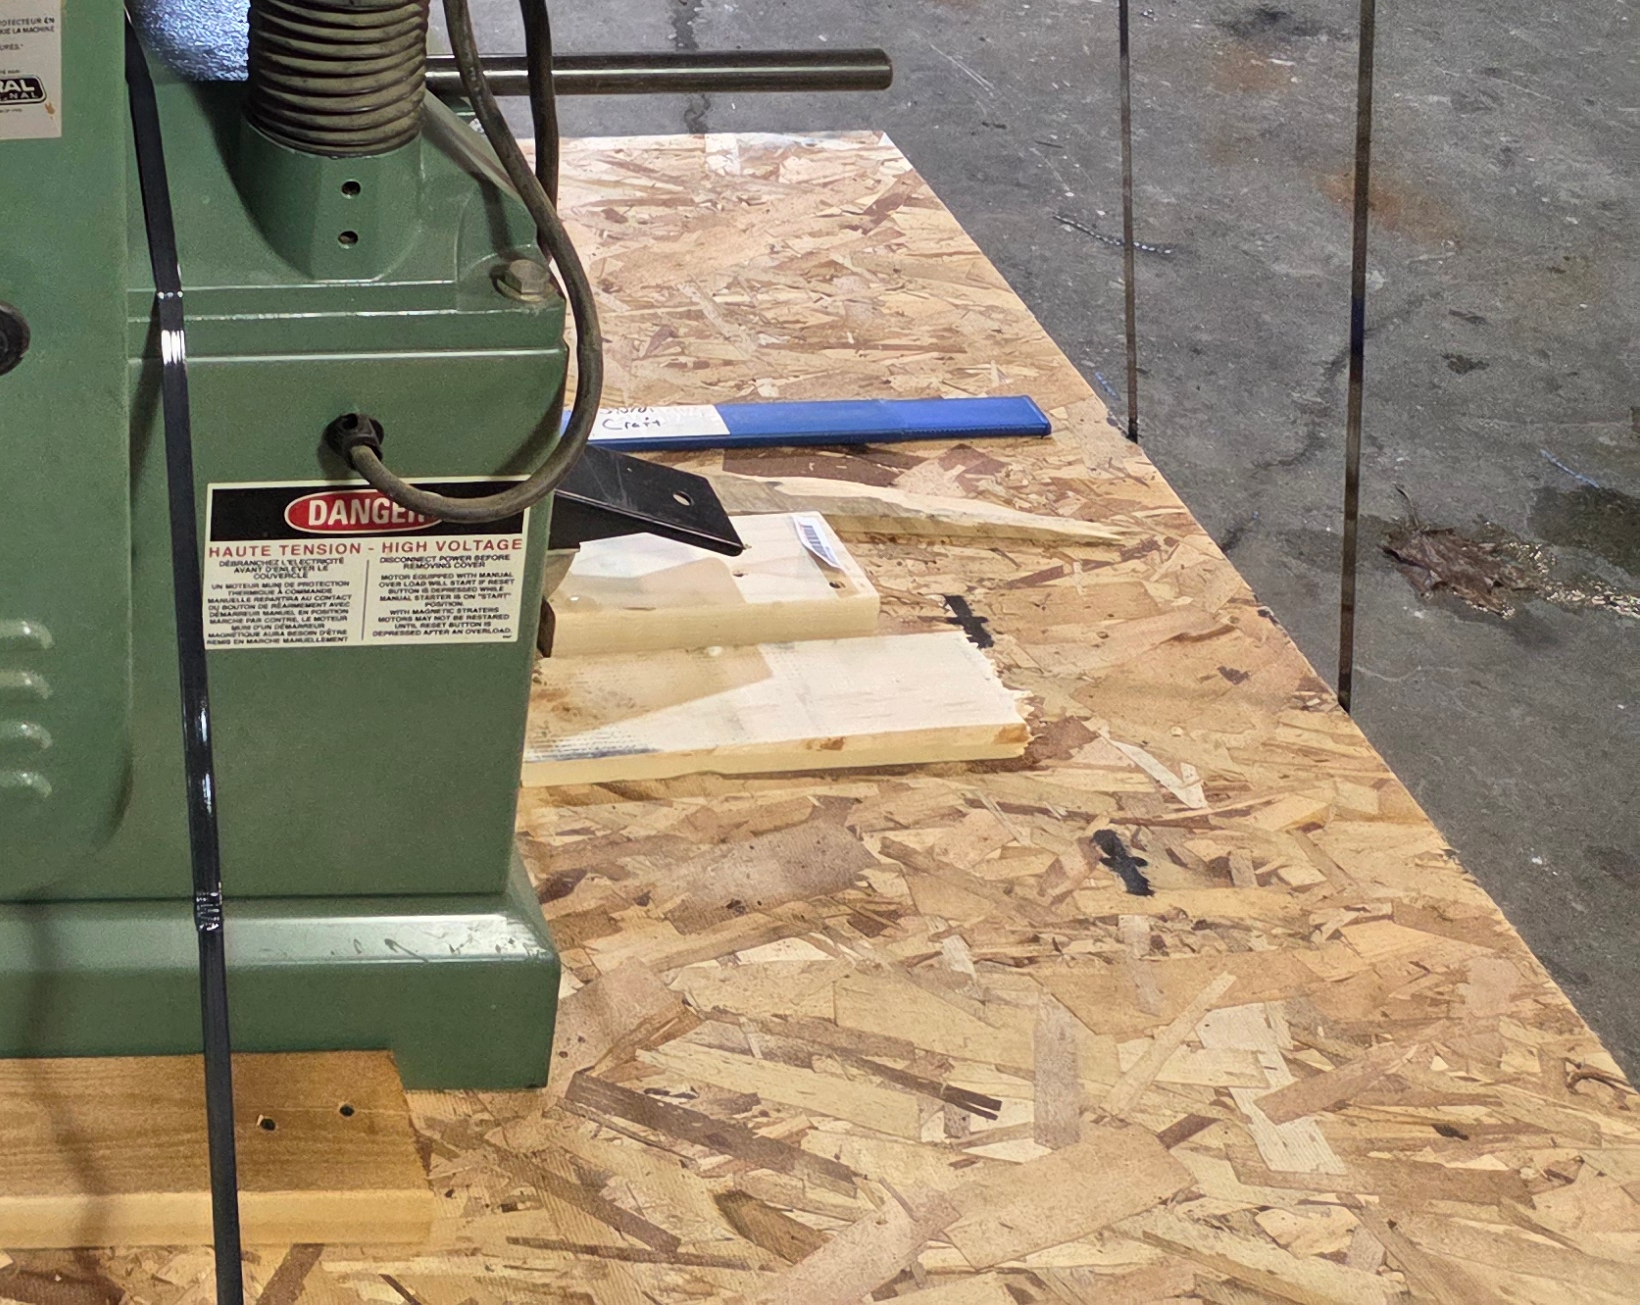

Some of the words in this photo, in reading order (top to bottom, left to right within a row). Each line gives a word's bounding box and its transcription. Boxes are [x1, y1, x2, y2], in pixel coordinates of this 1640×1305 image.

[22, 25, 54, 33] MACHINE
[209, 545, 271, 558] HAUTE
[279, 543, 361, 556] TENSION
[382, 541, 427, 553] HIGH
[436, 538, 523, 552] VOLTAGE
[234, 566, 262, 574] AVANT
[254, 572, 308, 580] COUVERCLE
